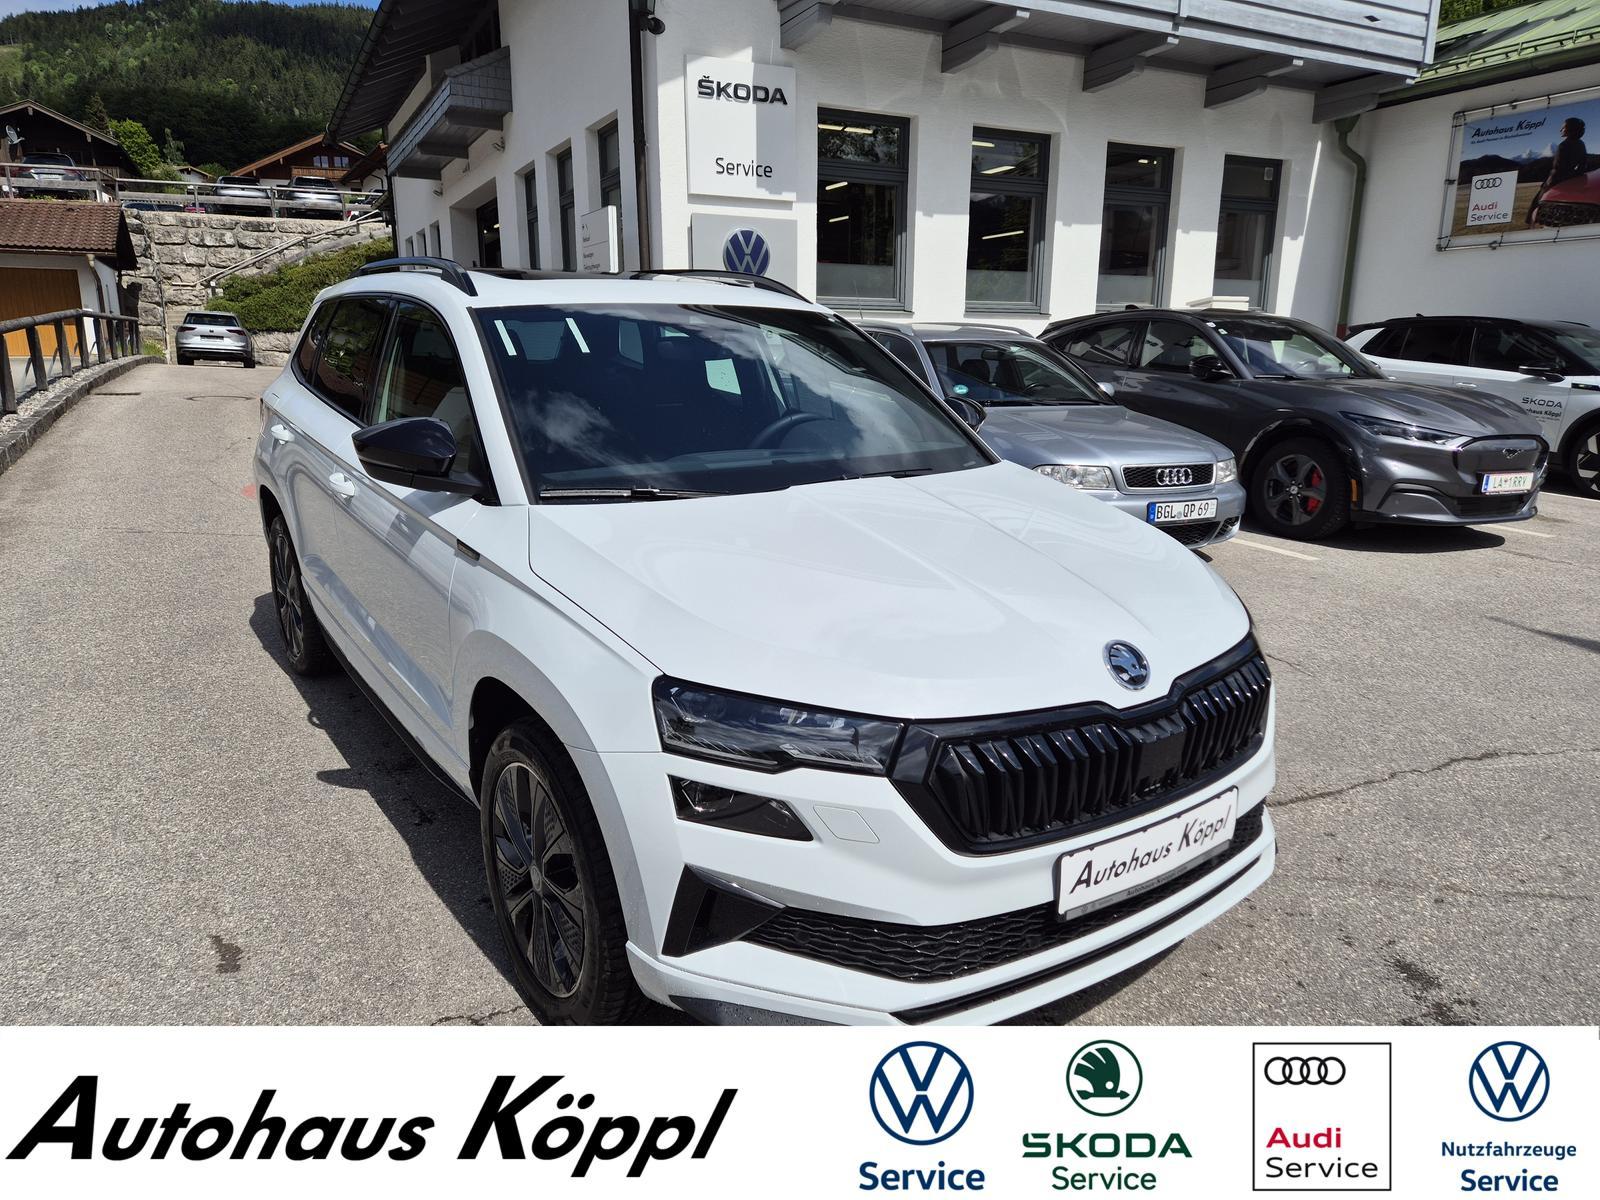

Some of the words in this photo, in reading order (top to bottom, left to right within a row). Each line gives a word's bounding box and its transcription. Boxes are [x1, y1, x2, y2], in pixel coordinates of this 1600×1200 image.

[698, 75, 788, 105] ŠKODA
[1472, 126, 1514, 138] Autohaus
[1516, 117, 1547, 131] Köppl
[716, 157, 773, 179] Service
[1470, 212, 1508, 222] Service
[1472, 201, 1498, 212] Audi
[1157, 505, 1176, 519] BGL
[1183, 504, 1195, 518] QP
[1197, 502, 1209, 516] 69
[1069, 841, 1173, 894] Autohaus
[1178, 805, 1231, 852] Köppl
